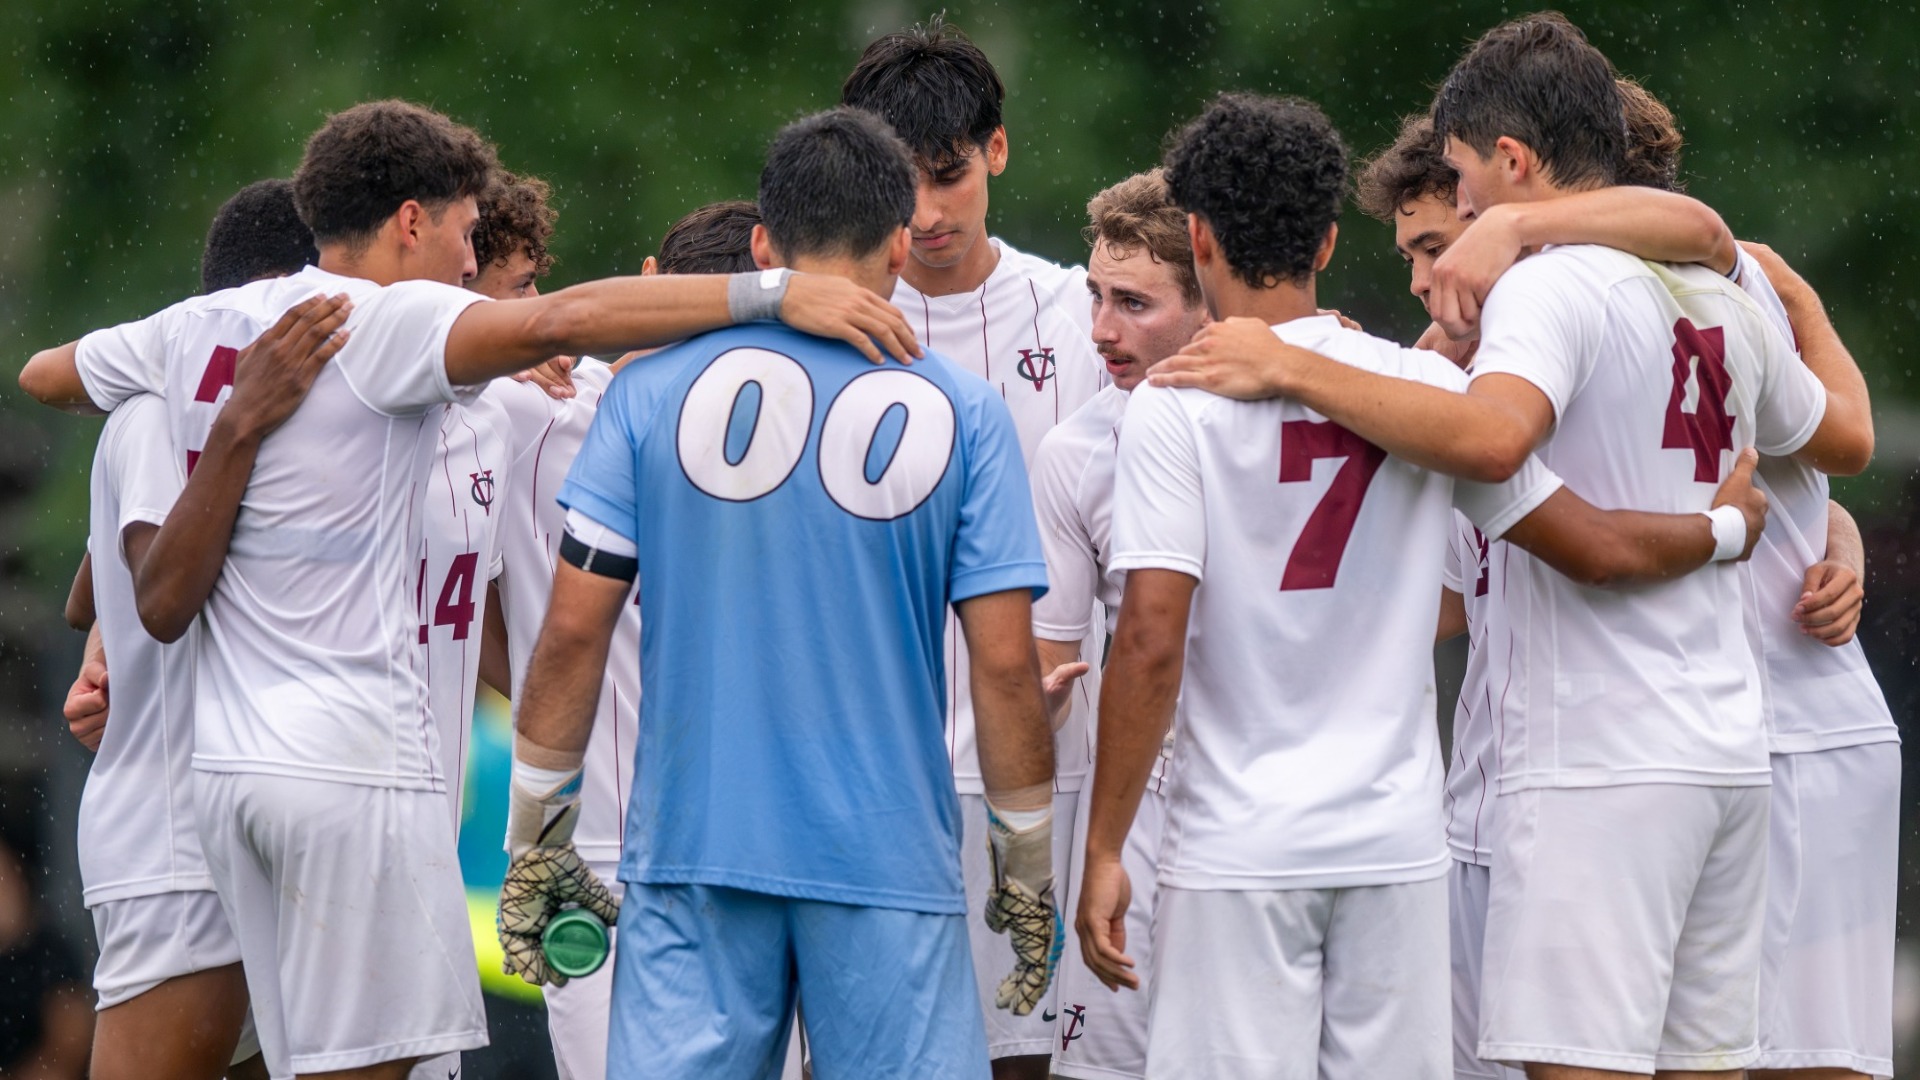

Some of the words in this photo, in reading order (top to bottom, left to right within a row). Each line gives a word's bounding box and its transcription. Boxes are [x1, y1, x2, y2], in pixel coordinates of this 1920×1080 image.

[676, 345, 956, 522] 00
[1661, 317, 1736, 483] 4
[1279, 419, 1389, 591] 7
